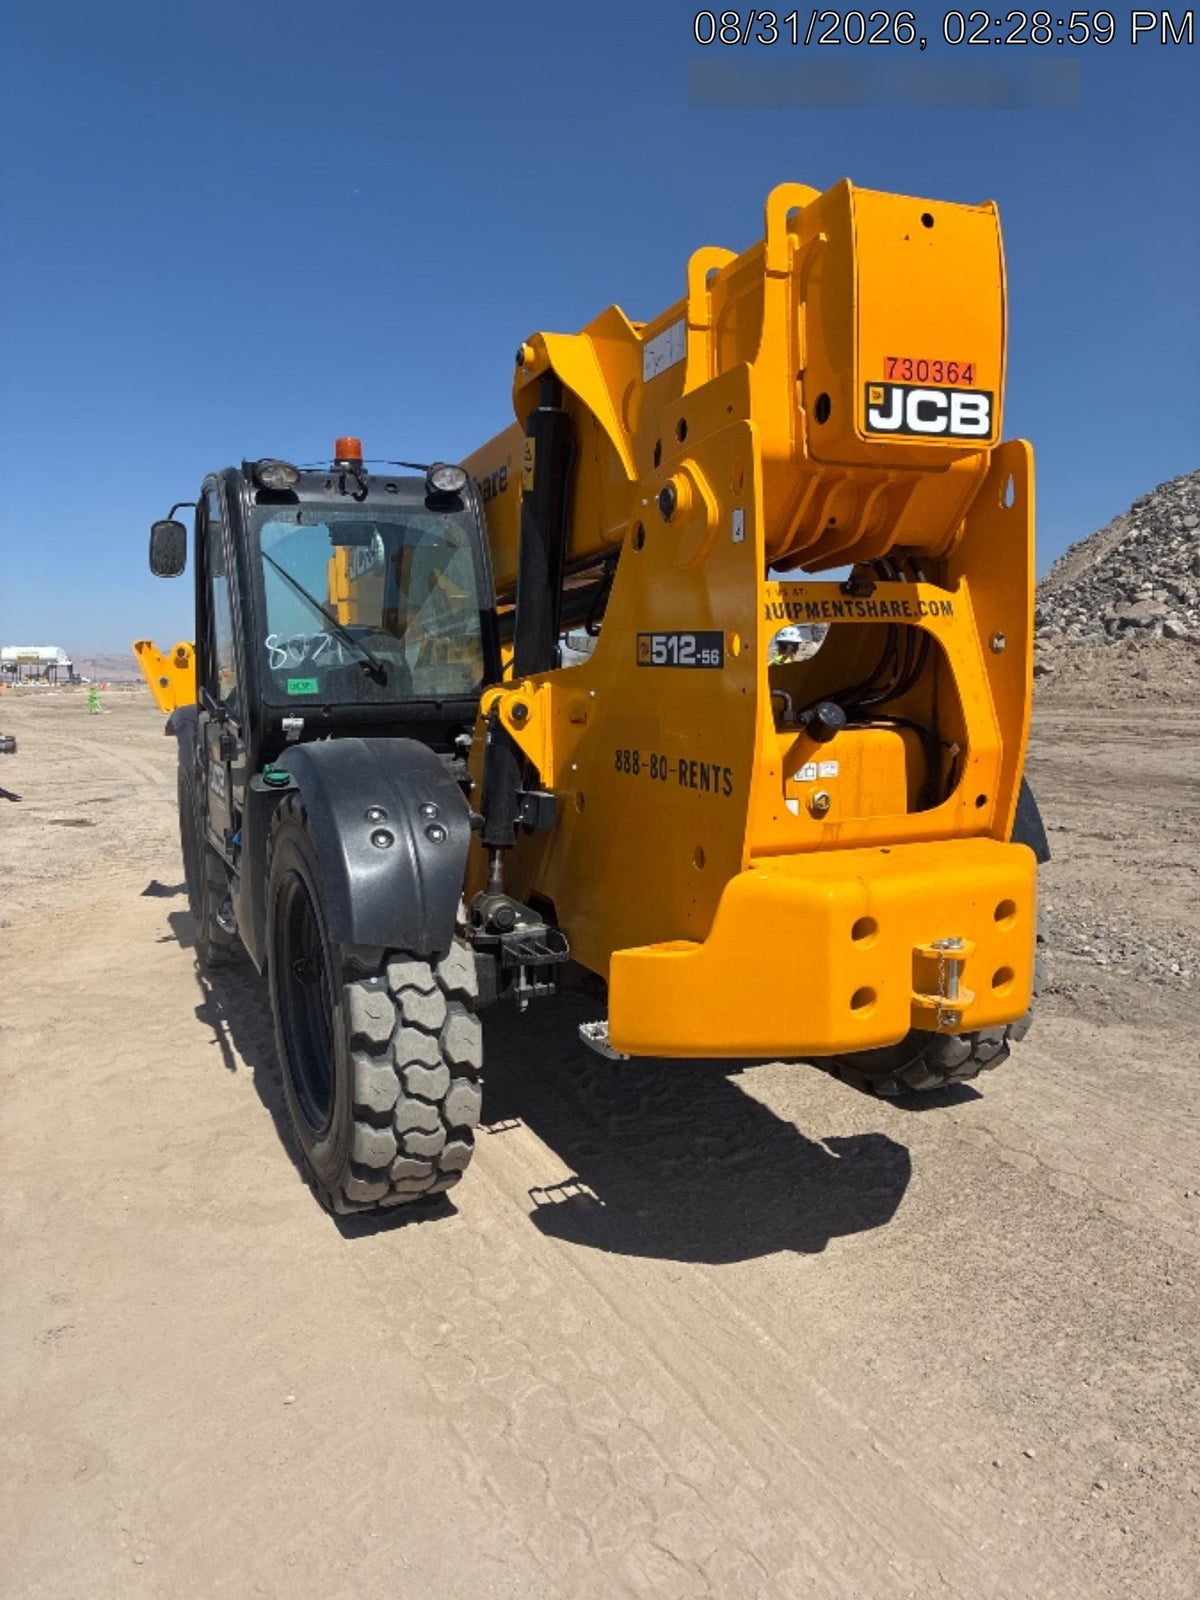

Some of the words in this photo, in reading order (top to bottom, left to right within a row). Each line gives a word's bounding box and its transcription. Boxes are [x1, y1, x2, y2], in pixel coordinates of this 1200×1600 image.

[886, 356, 974, 385] 730364
[868, 387, 990, 435] JCB
[614, 749, 734, 798] 888-80-RENTS
